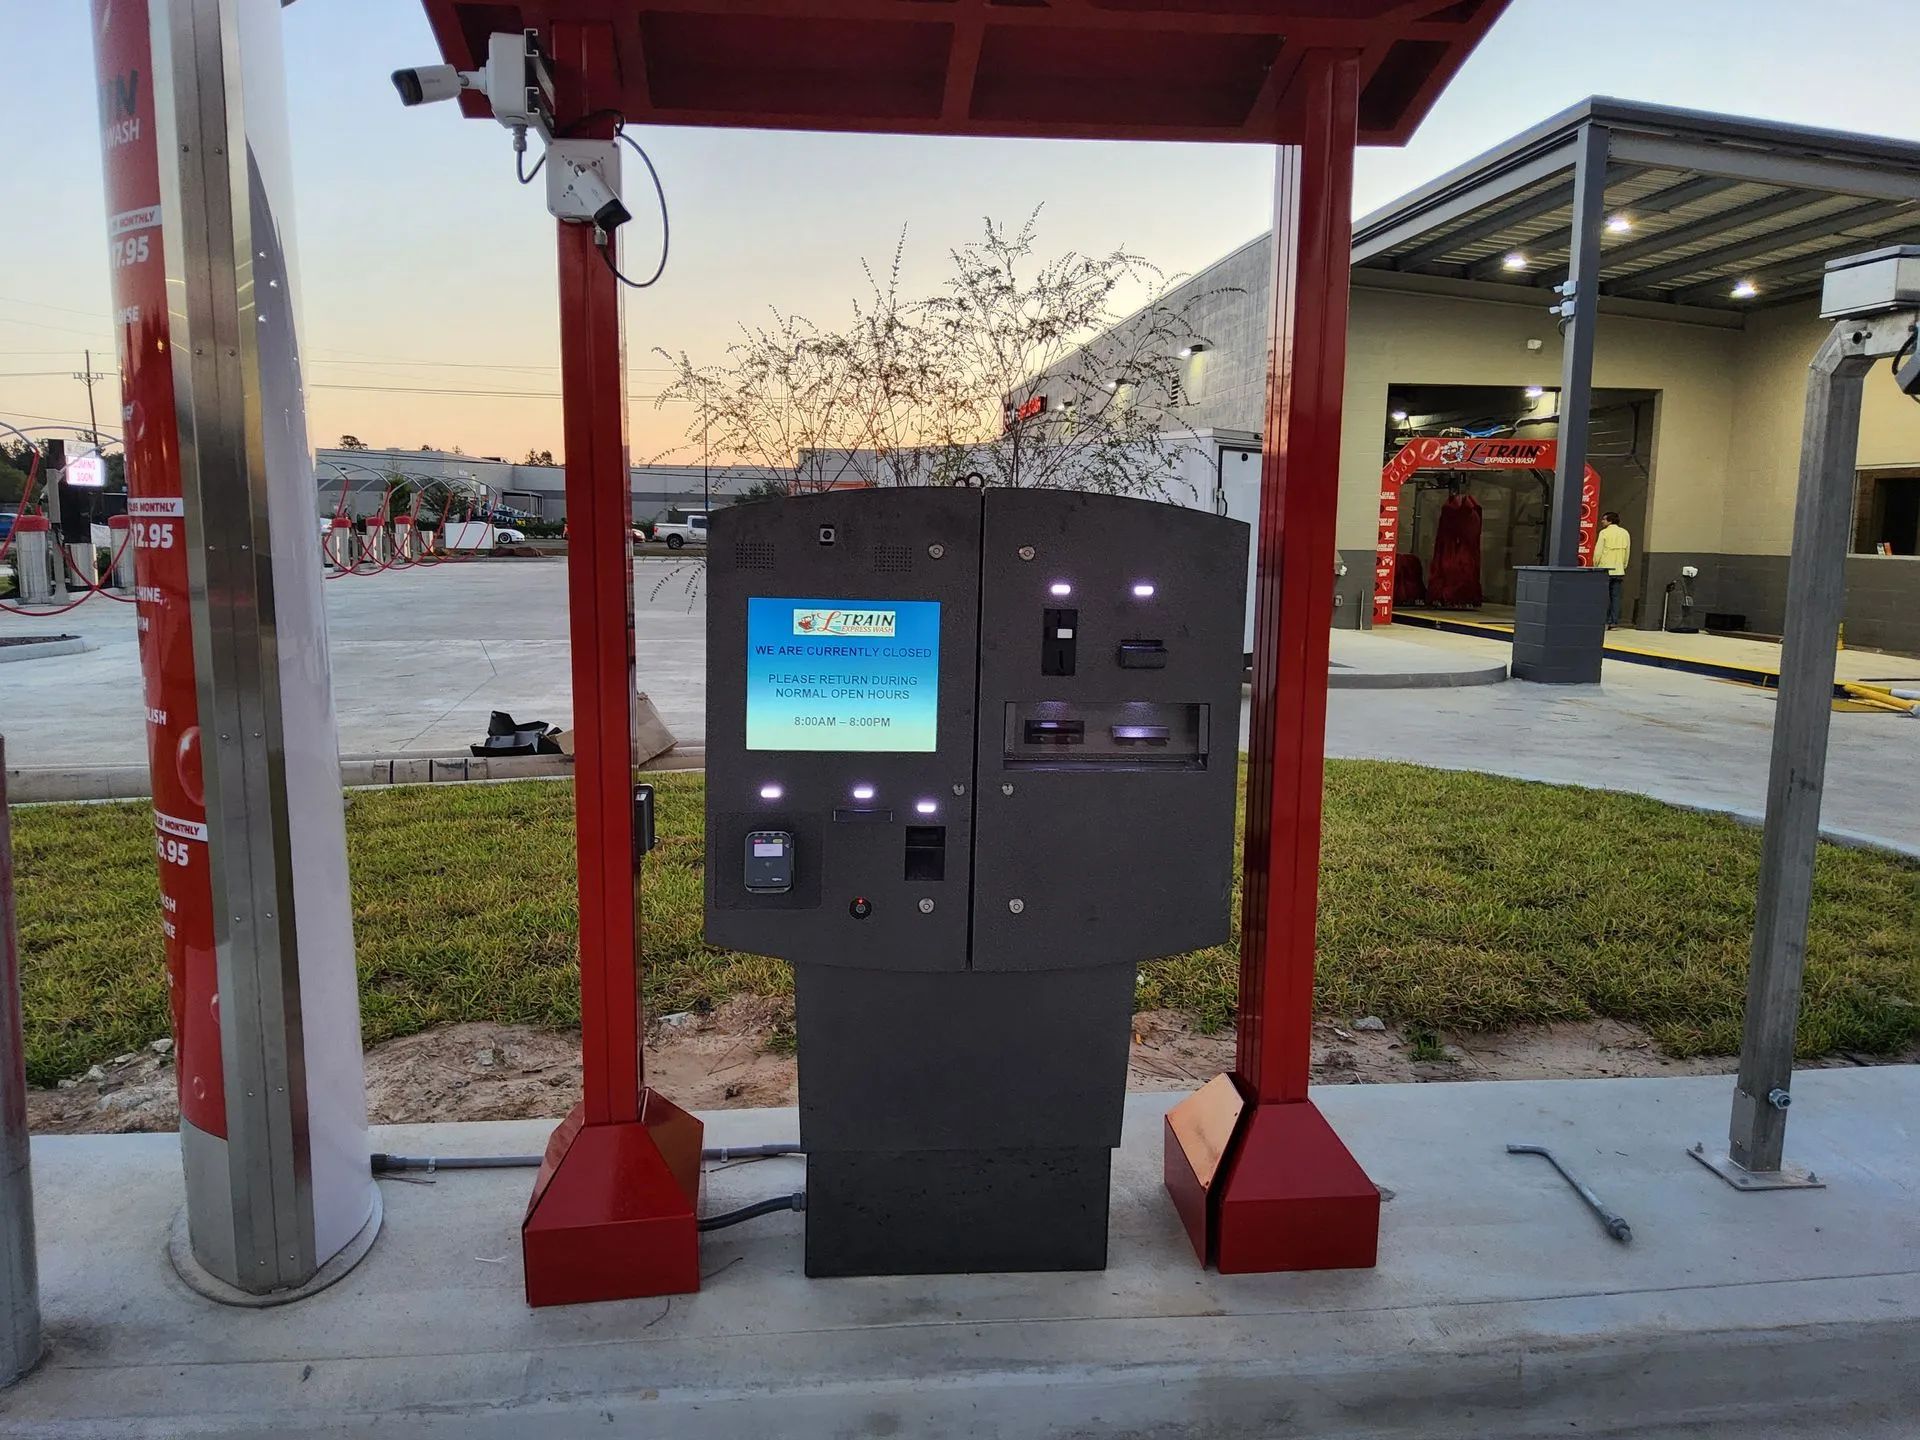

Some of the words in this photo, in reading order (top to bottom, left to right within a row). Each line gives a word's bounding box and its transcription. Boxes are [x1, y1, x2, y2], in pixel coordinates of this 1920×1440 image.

[1484, 456, 1514, 464] EXPRESS
[1515, 457, 1536, 465] WASH
[140, 502, 176, 513] MONTHLY
[841, 625, 872, 633] EXPRESS
[755, 645, 774, 656] WE
[778, 646, 802, 656] ARE
[806, 646, 880, 657] CURRENTLY
[883, 647, 932, 658] CLOSED
[768, 673, 816, 685] PLEASE
[820, 674, 868, 686] RETURN
[871, 675, 918, 686] DURING
[775, 688, 827, 699] NORMAL
[831, 689, 864, 700] OPEN
[868, 690, 910, 700] HOURS
[794, 716, 836, 727] 8:00AM
[849, 717, 891, 728] 8:00PM
[164, 819, 200, 837] MONTHLY
